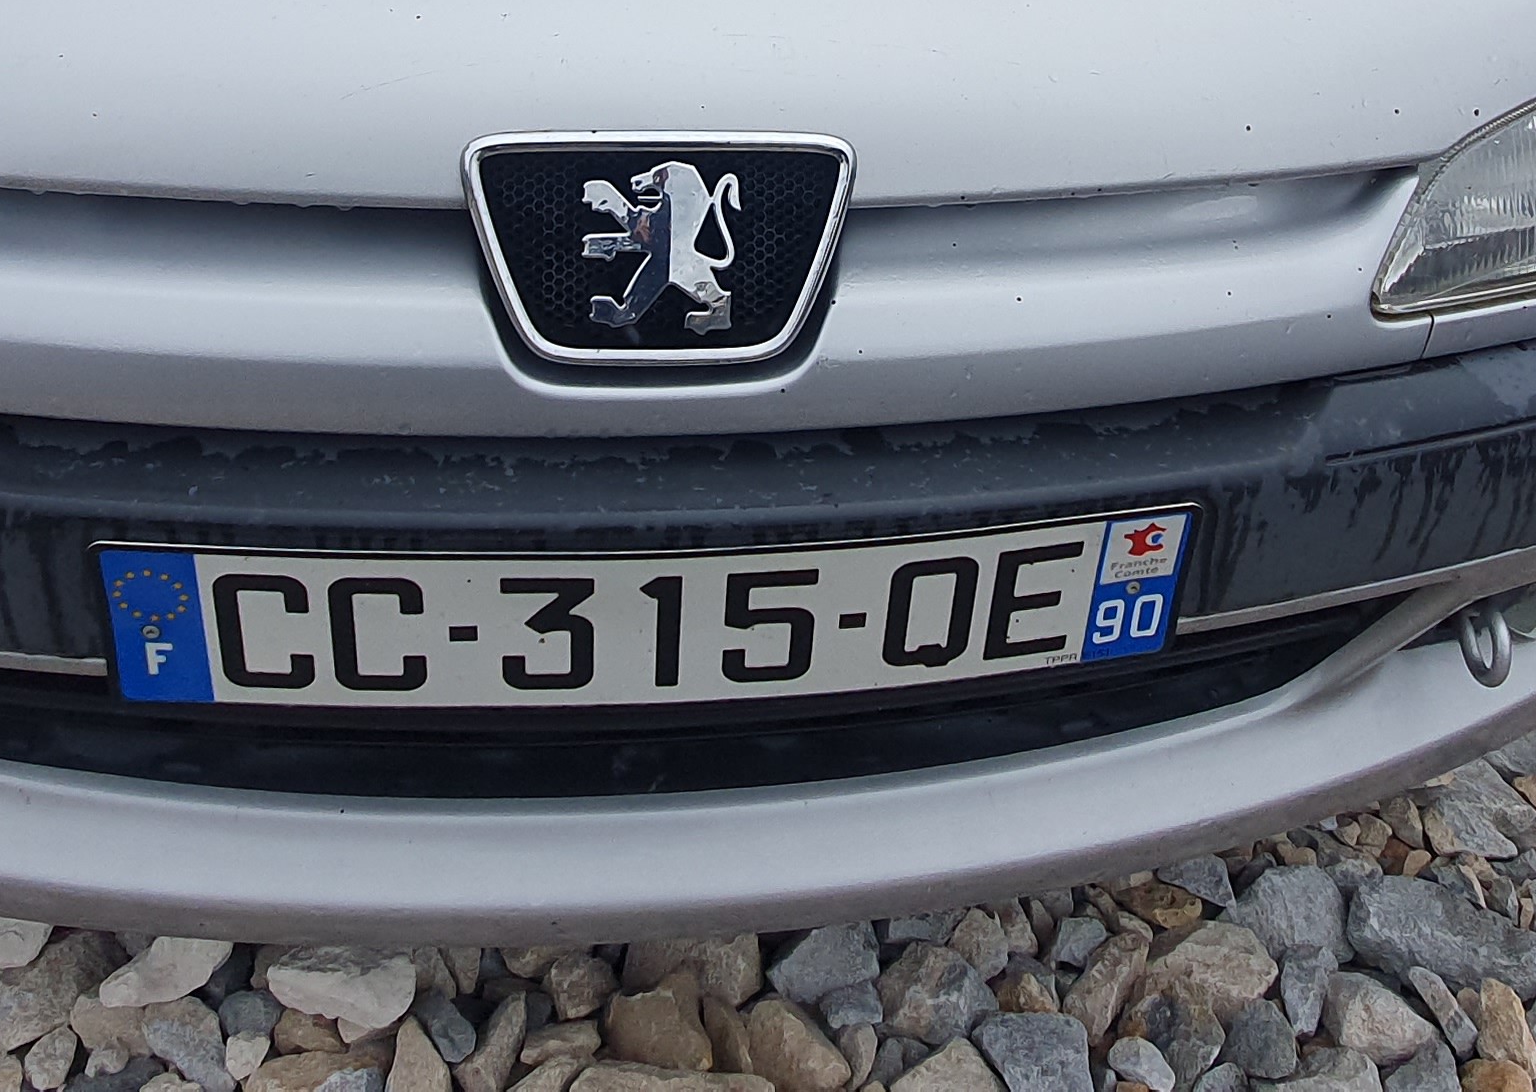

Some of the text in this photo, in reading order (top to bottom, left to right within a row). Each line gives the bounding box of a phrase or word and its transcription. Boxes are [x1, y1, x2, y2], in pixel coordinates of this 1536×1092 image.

[1110, 557, 1168, 571] Franche
[212, 541, 1084, 691] CC-315-QE
[1092, 593, 1164, 645] 90
[144, 642, 173, 675] F
